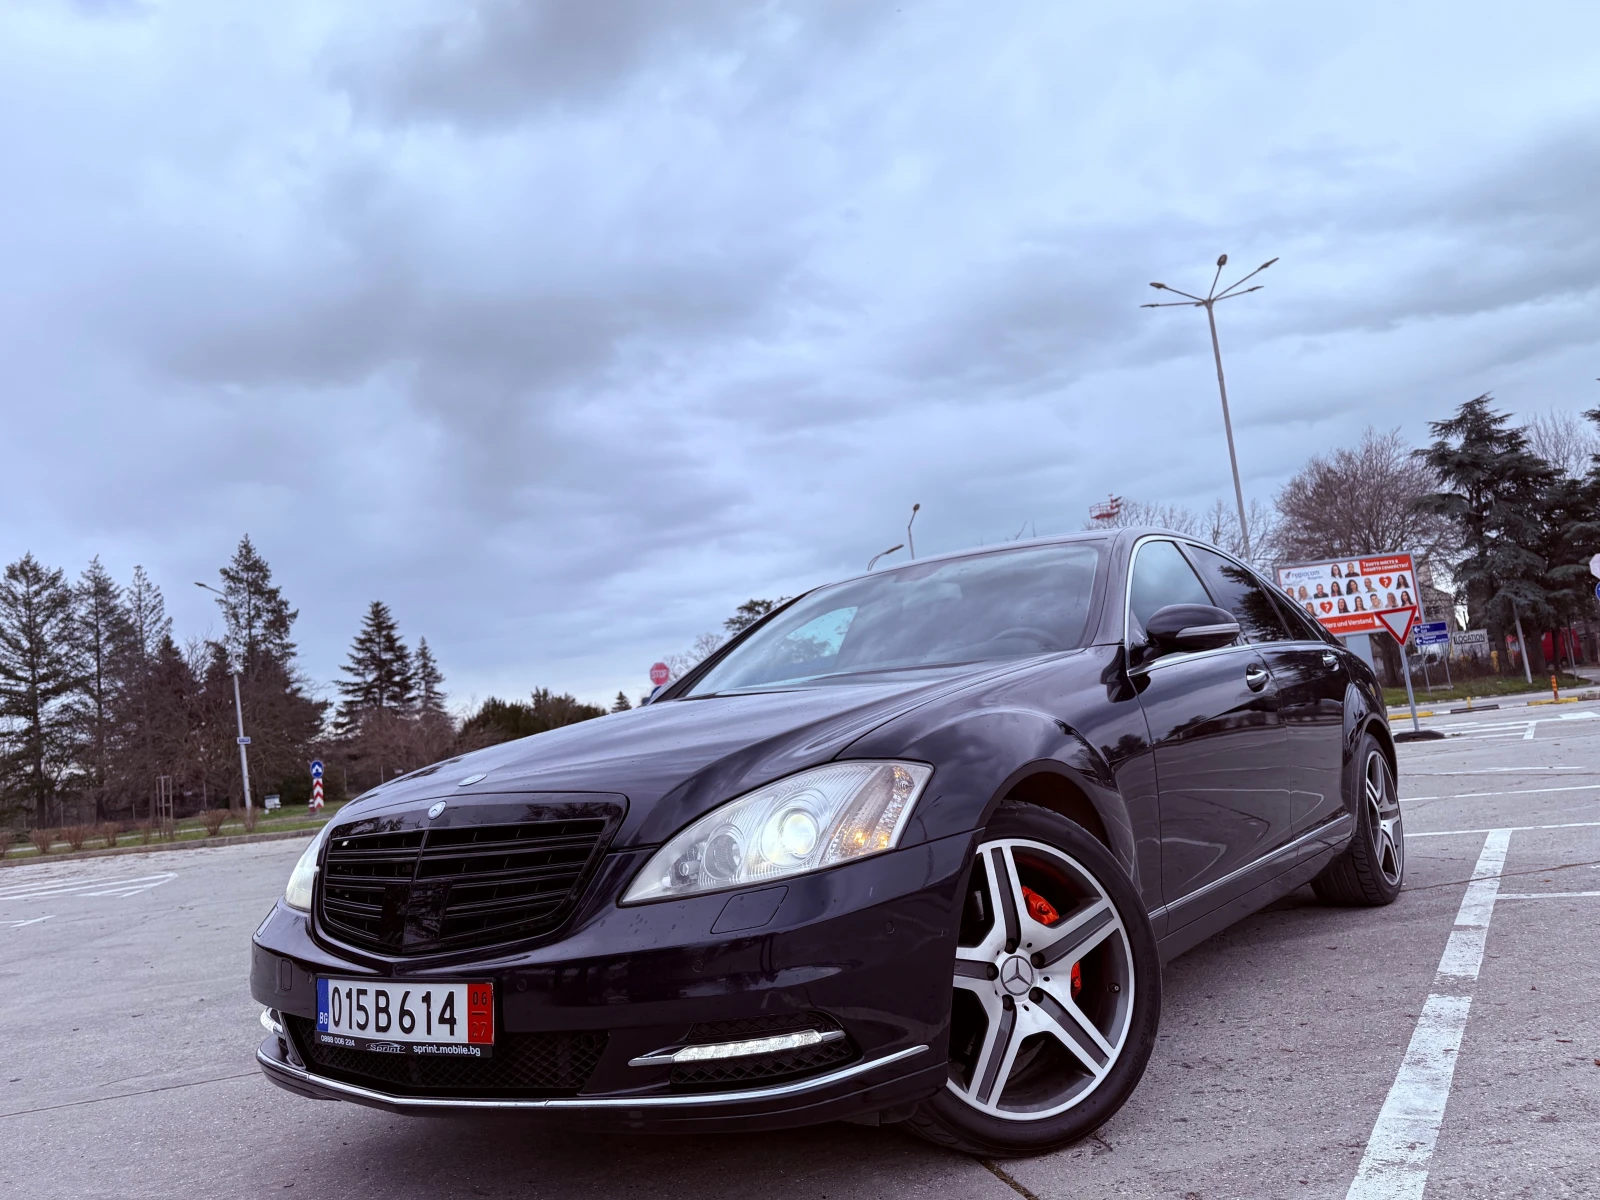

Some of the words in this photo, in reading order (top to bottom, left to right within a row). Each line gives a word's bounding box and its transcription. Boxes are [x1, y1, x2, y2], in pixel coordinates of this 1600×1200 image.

[1291, 570, 1320, 579] regiocom
[1456, 633, 1485, 643] LOCATION
[651, 670, 667, 679] STOP
[472, 991, 488, 1006] 06
[332, 986, 457, 1036] 015B614
[319, 1011, 328, 1025] BG
[472, 1022, 487, 1037] 27
[370, 1044, 401, 1053] Sprint
[413, 1044, 481, 1056] sprint.mobile.bg
